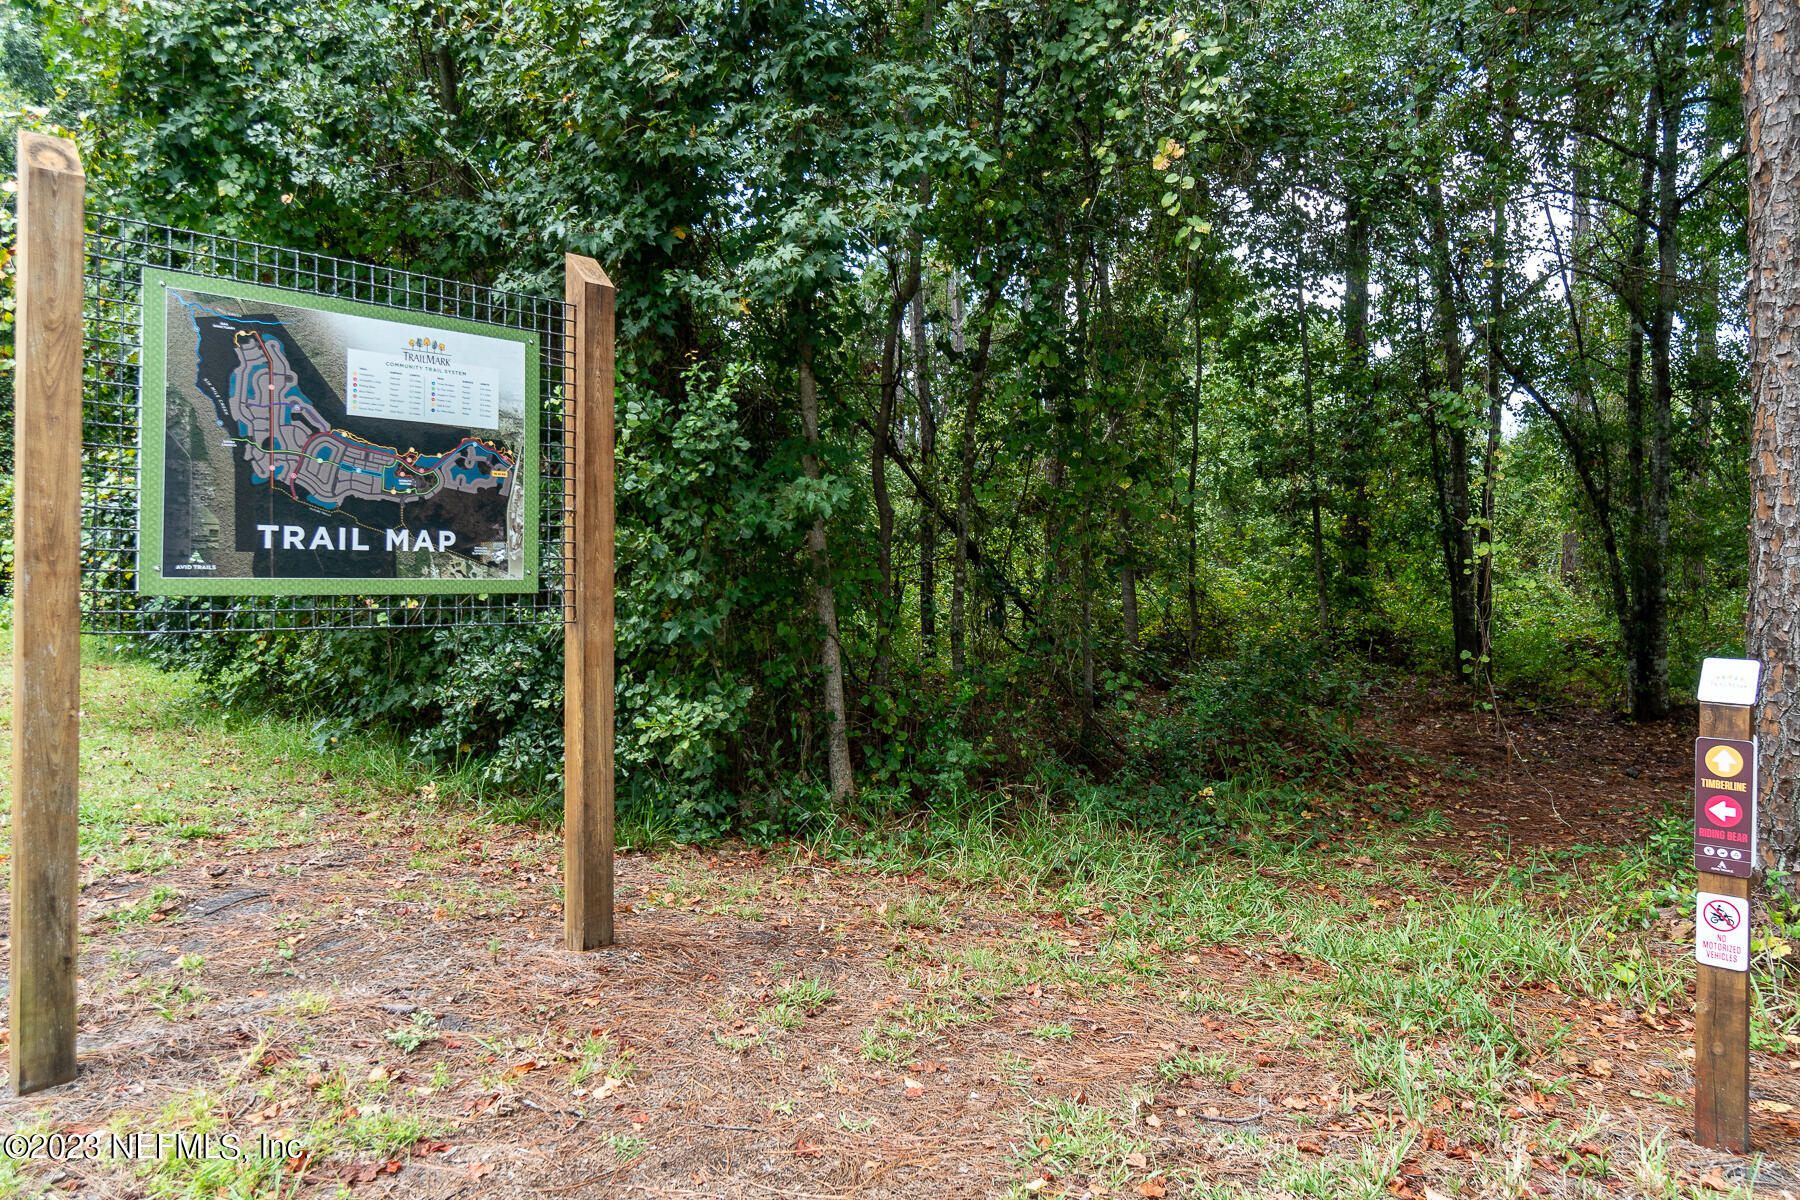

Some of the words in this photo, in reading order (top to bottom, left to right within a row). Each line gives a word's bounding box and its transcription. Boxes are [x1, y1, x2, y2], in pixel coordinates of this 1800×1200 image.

[385, 361, 423, 371] COMMUNITY
[425, 366, 442, 374] TRAIL
[444, 369, 467, 377] SYSTEM
[256, 523, 370, 551] TRAIL
[386, 528, 457, 553] MAP
[1700, 777, 1747, 793] TIMBERLINE
[1698, 827, 1726, 840] RIDING
[1726, 831, 1748, 843] BEAR
[1717, 933, 1727, 942] NO
[1702, 940, 1741, 955] MOTORIZED
[1706, 950, 1738, 963] VEHICLES
